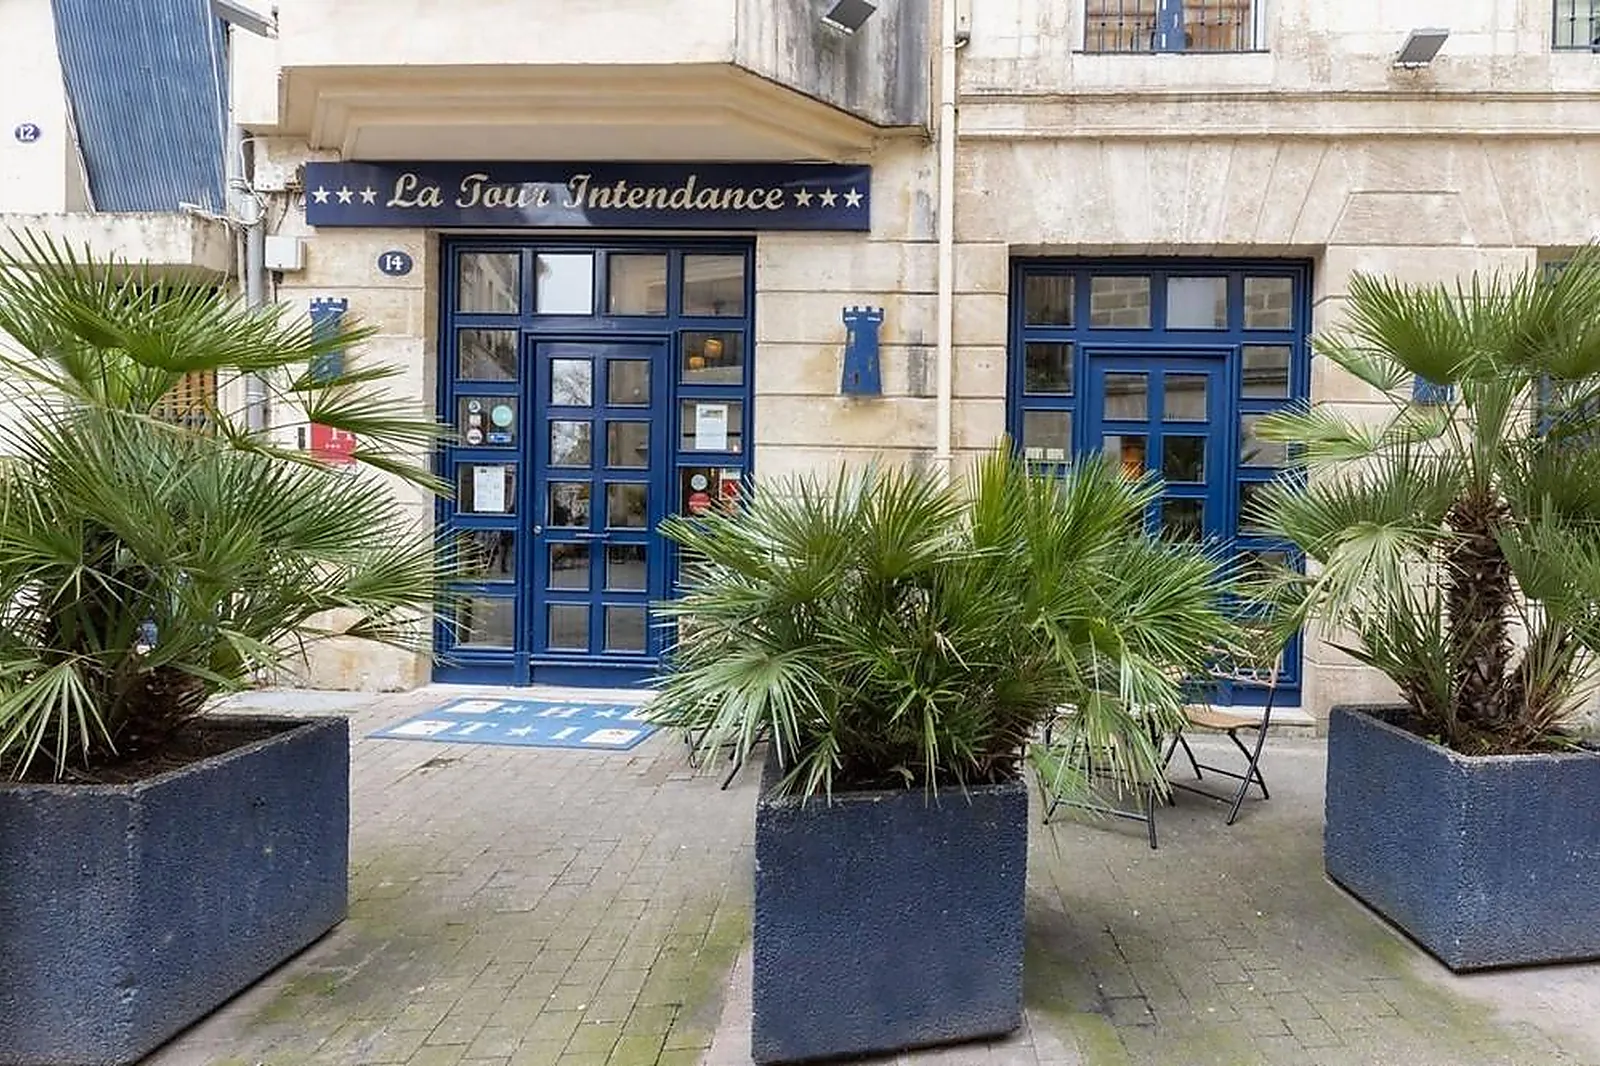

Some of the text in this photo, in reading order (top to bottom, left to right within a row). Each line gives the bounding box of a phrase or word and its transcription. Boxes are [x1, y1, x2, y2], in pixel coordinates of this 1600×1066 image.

[20, 126, 35, 140] 12
[386, 172, 785, 209] La Tour Intendance
[386, 254, 403, 270] 14
